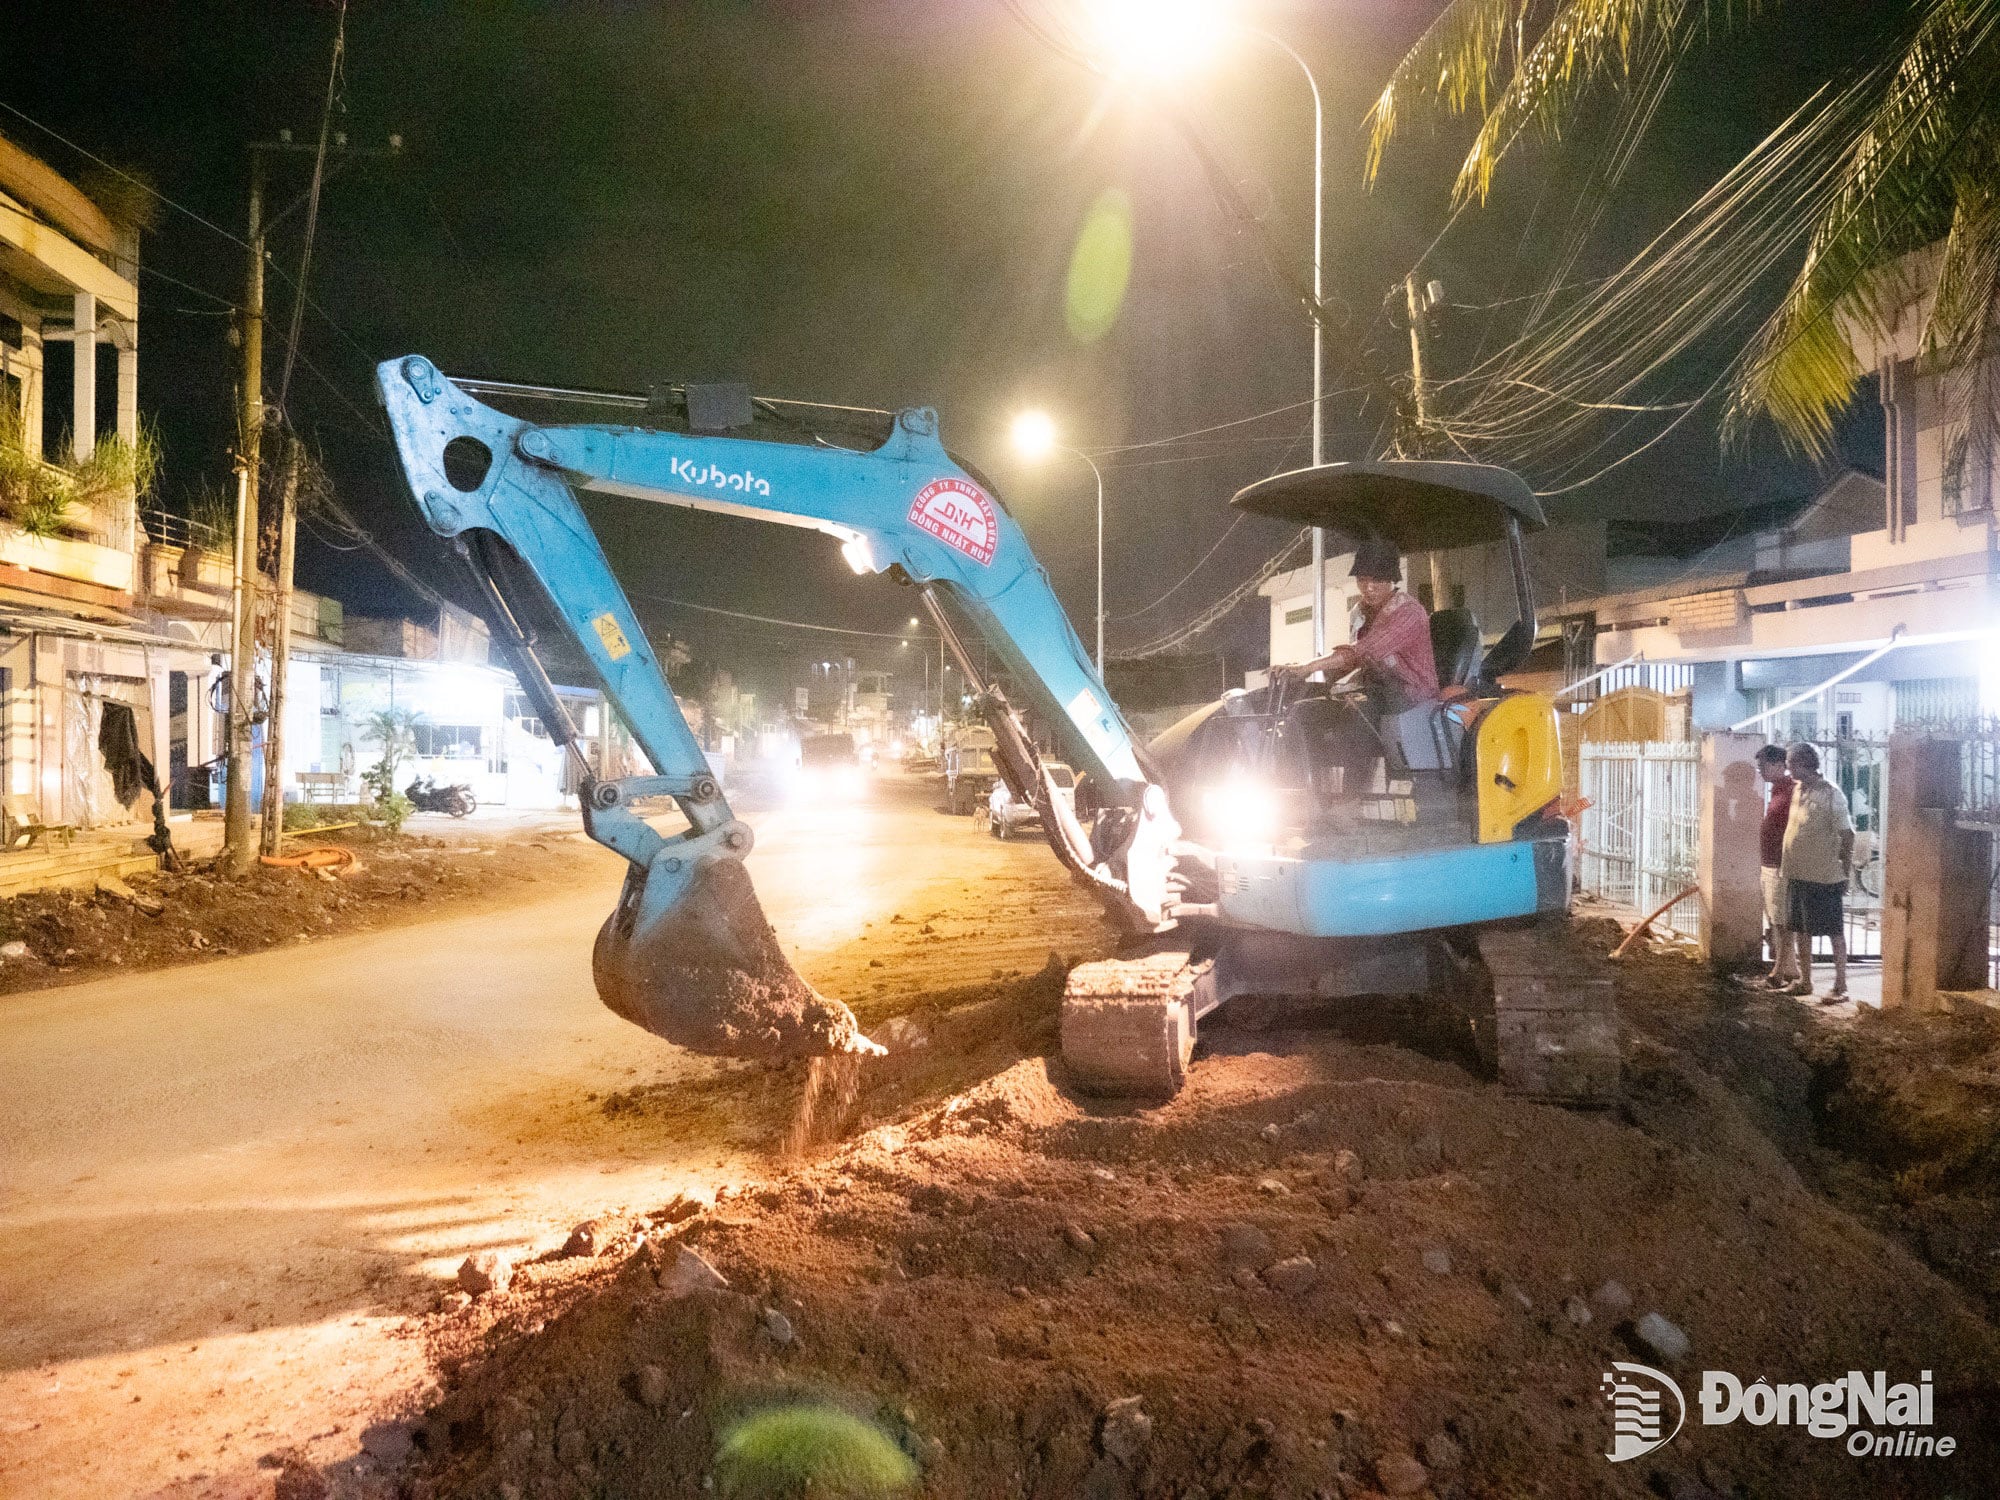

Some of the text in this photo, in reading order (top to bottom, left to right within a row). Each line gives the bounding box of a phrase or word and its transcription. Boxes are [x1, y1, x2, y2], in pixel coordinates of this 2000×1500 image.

[670, 456, 770, 496] Kubota
[939, 481, 949, 490] TY
[954, 482, 977, 498] TNHH
[970, 545, 991, 562] HUY
